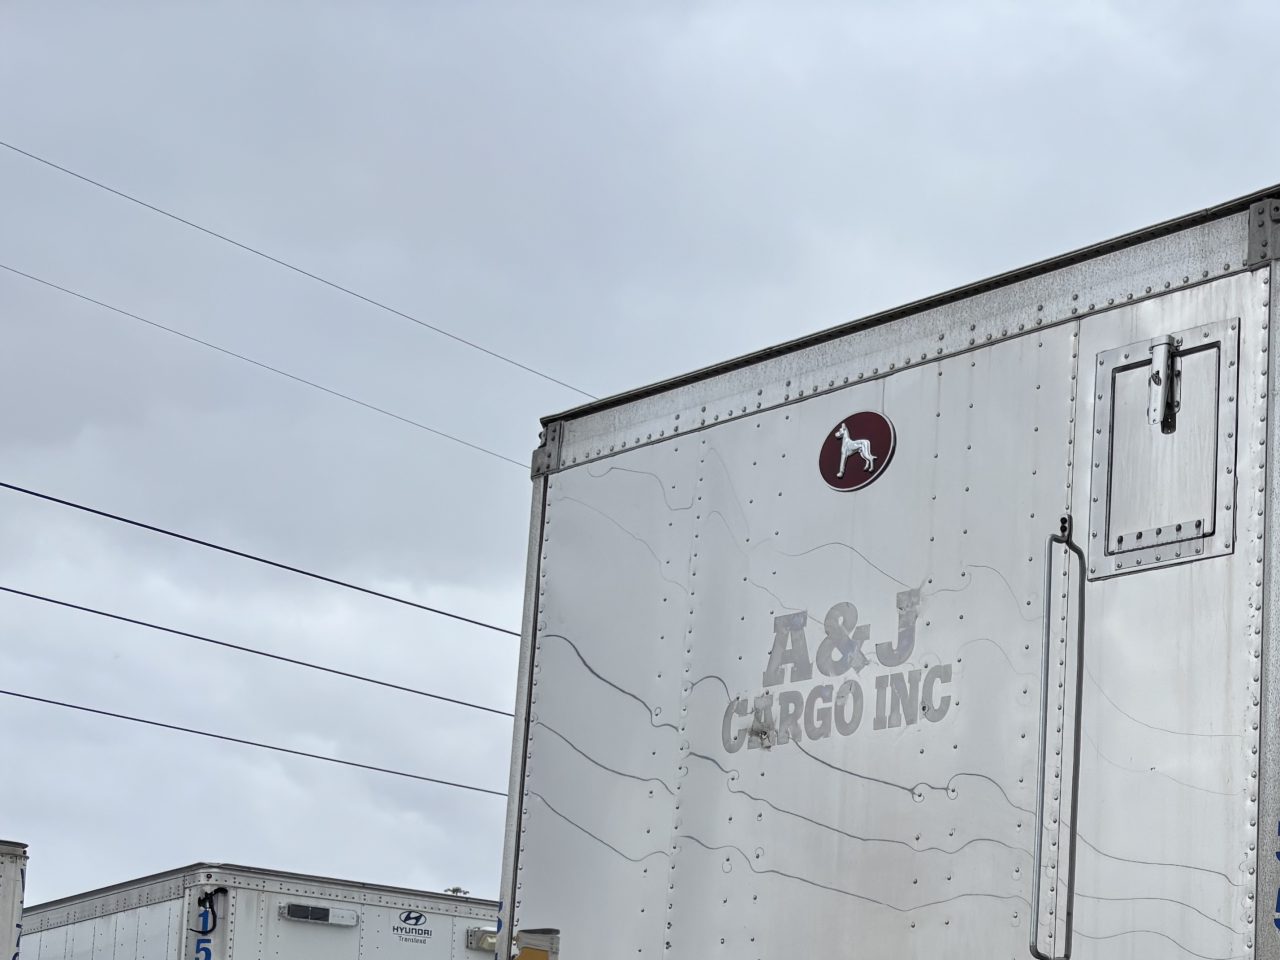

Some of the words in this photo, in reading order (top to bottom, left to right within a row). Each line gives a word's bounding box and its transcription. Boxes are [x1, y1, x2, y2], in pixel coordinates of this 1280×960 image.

[762, 588, 921, 688] A&J
[722, 680, 864, 754] CARGO
[873, 664, 953, 730] INC
[392, 925, 433, 937] HYUNDAI
[398, 936, 427, 945] Translead
